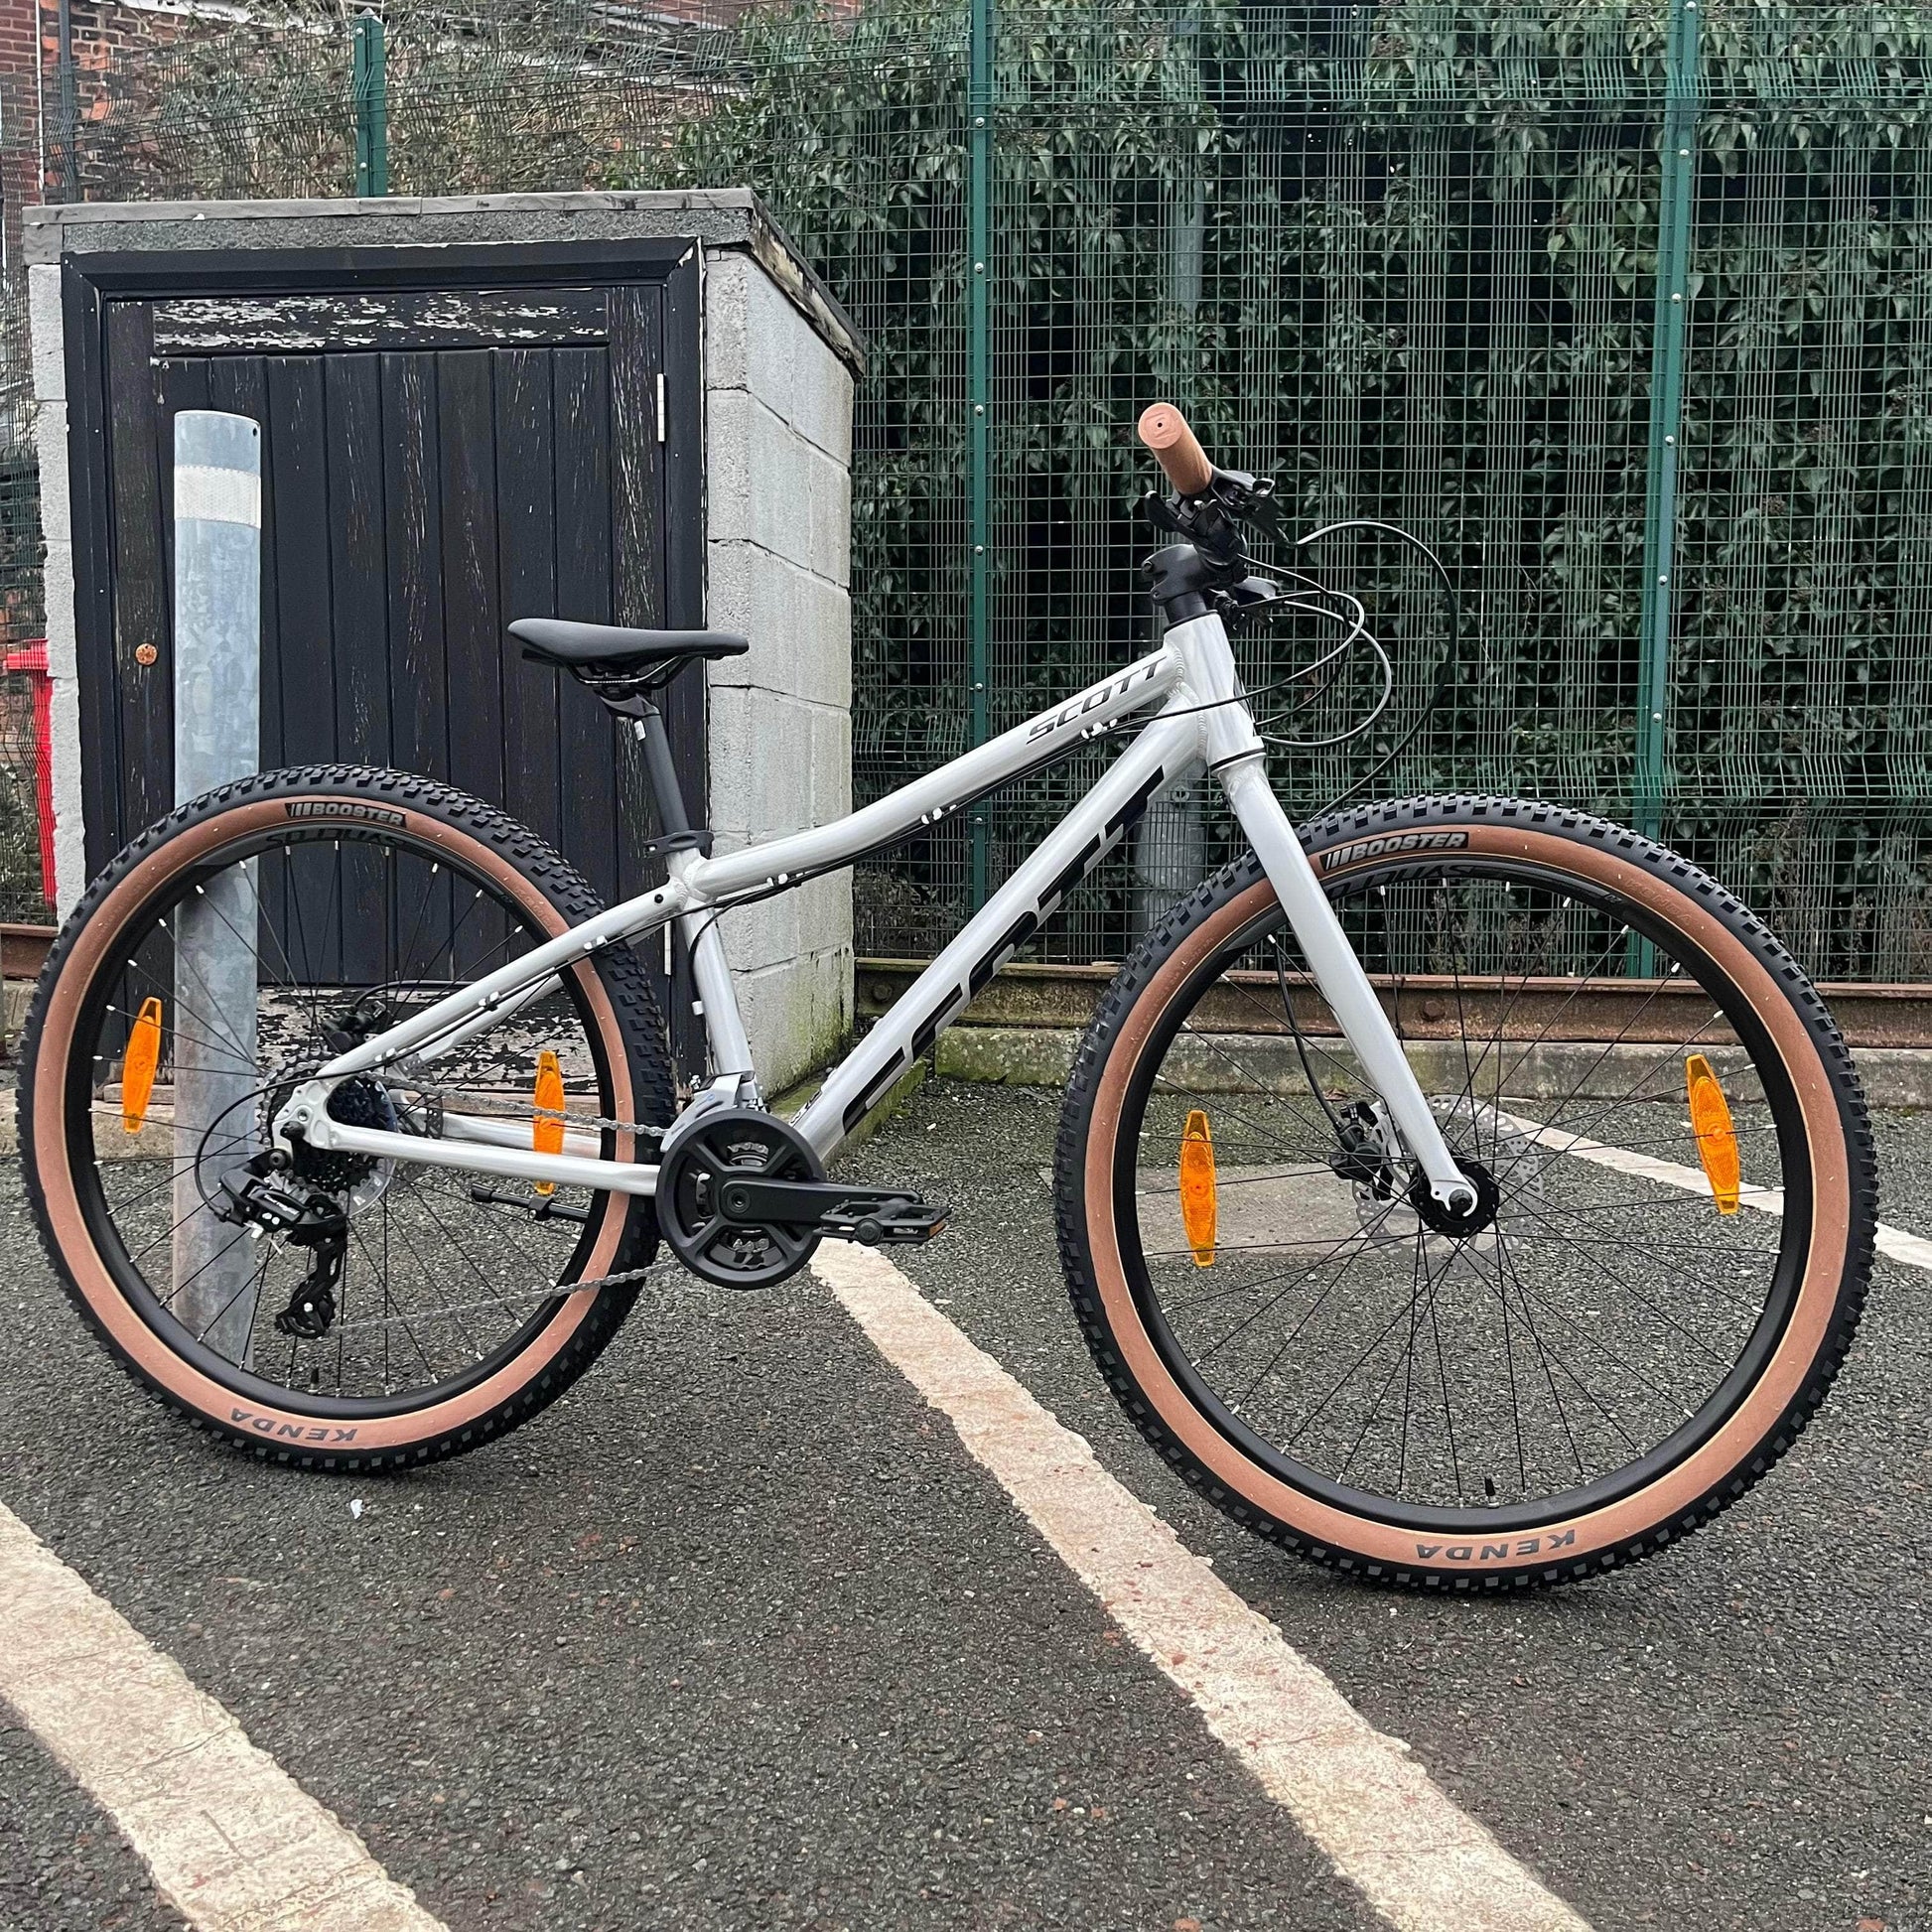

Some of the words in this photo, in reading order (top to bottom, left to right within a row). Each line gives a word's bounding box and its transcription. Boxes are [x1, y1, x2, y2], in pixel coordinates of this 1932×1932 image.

[1027, 656, 1167, 745] SCOTT
[312, 802, 404, 826] BOOSTER
[1350, 832, 1466, 862] BOOSTER
[230, 1408, 357, 1442] KENDA
[1416, 1529, 1576, 1560] KENDA
